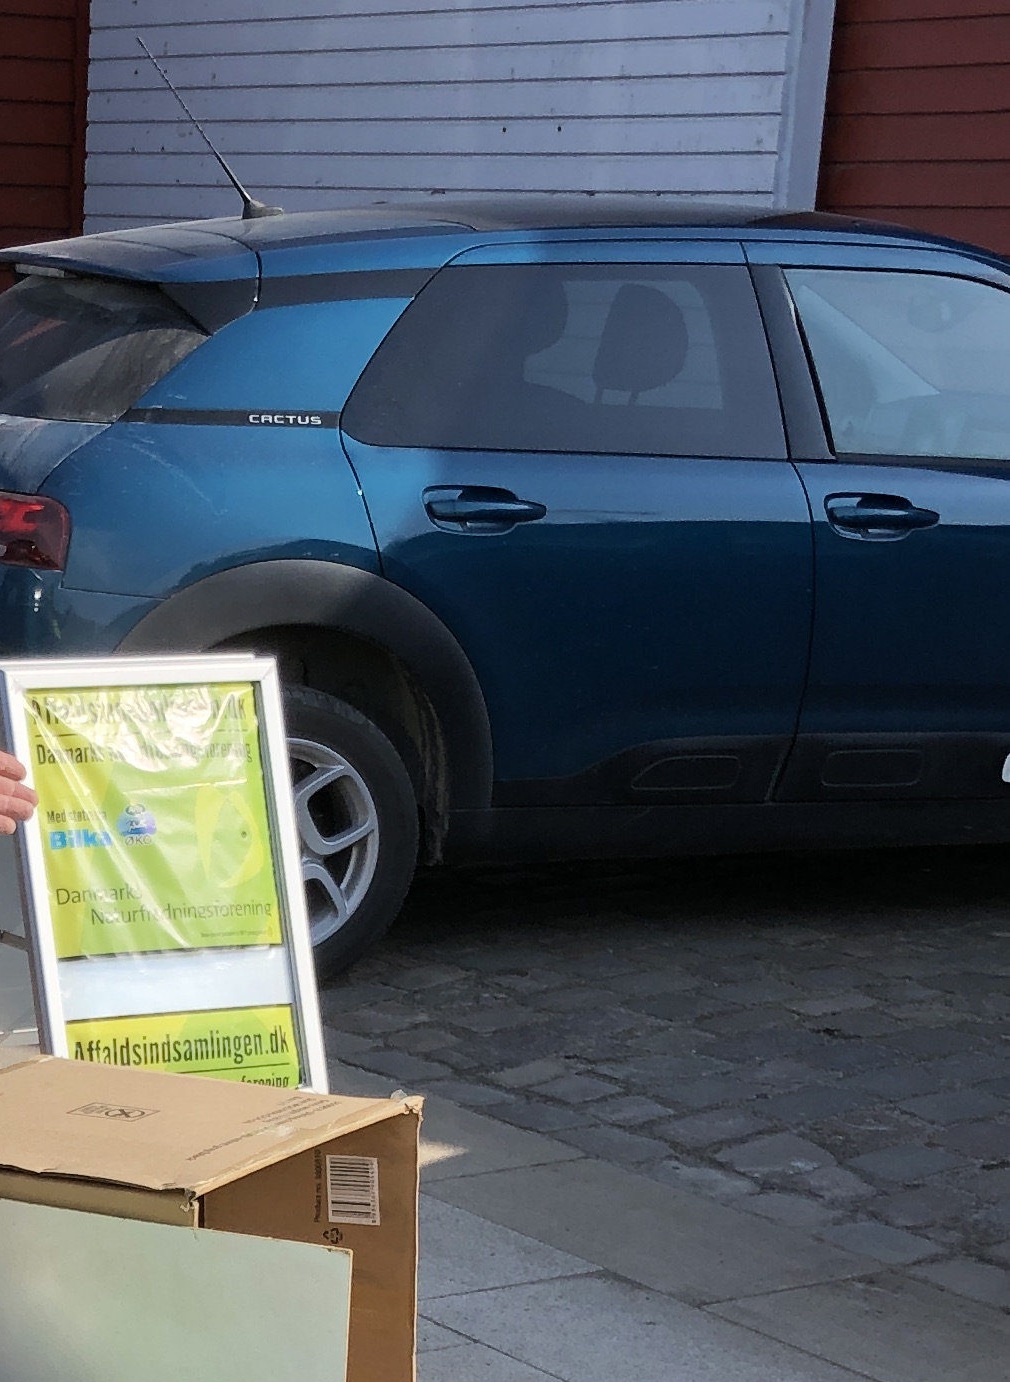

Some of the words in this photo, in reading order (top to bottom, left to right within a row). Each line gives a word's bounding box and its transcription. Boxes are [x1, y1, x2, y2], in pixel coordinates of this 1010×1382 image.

[248, 413, 322, 425] CACTUS
[50, 829, 112, 850] Bilka
[91, 899, 272, 925] Naturfrdningsforening
[75, 1025, 289, 1067] Affaldsindsamlingen.dk
